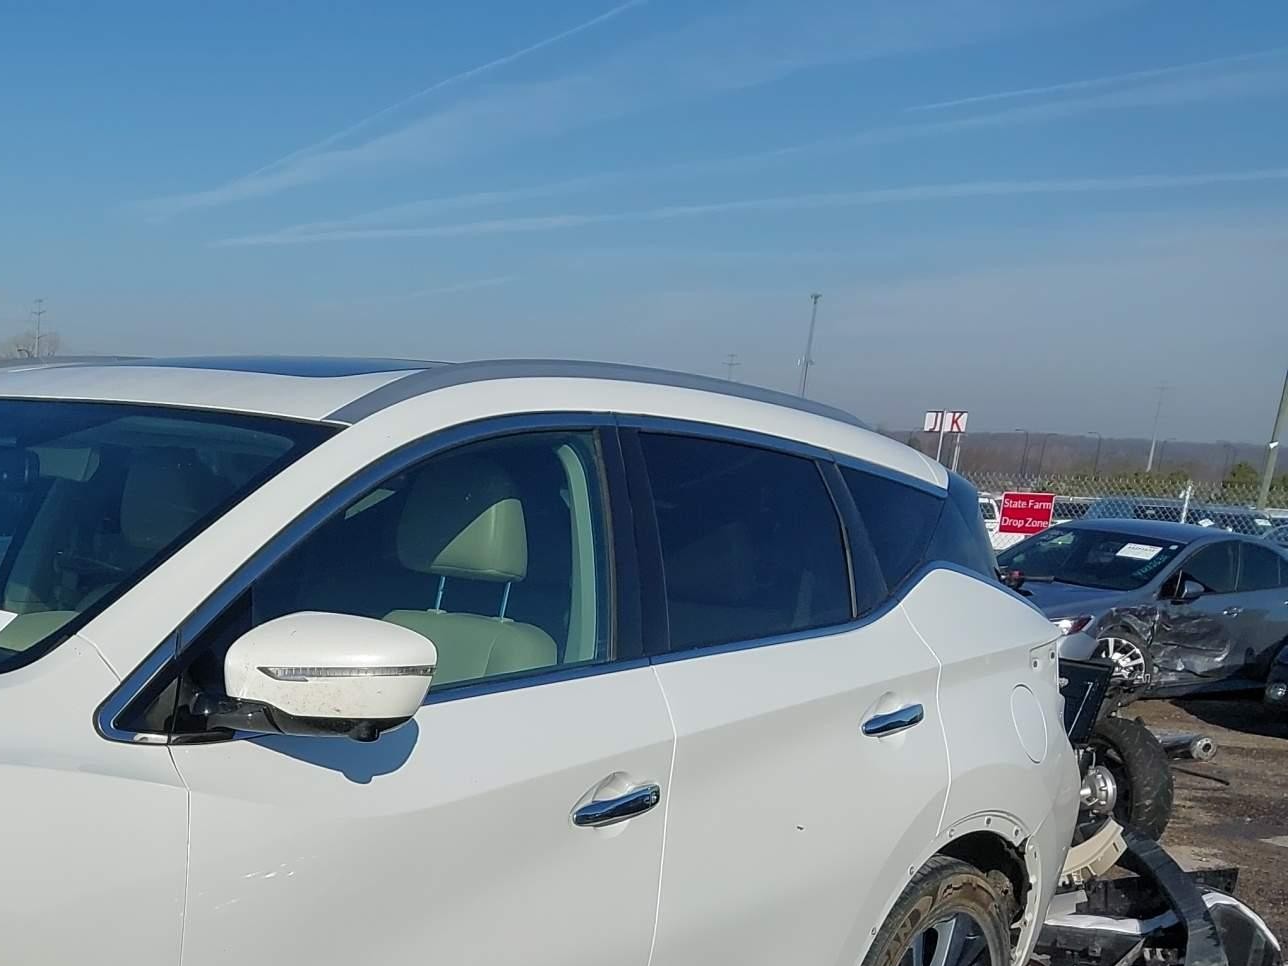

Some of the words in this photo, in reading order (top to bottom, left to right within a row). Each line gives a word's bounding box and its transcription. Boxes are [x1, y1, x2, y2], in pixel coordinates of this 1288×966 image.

[928, 411, 939, 432] J
[950, 411, 964, 433] K
[1003, 498, 1028, 509] State
[1028, 499, 1052, 510] Farm
[1001, 516, 1024, 528] Drop
[1024, 517, 1049, 528] Zone
